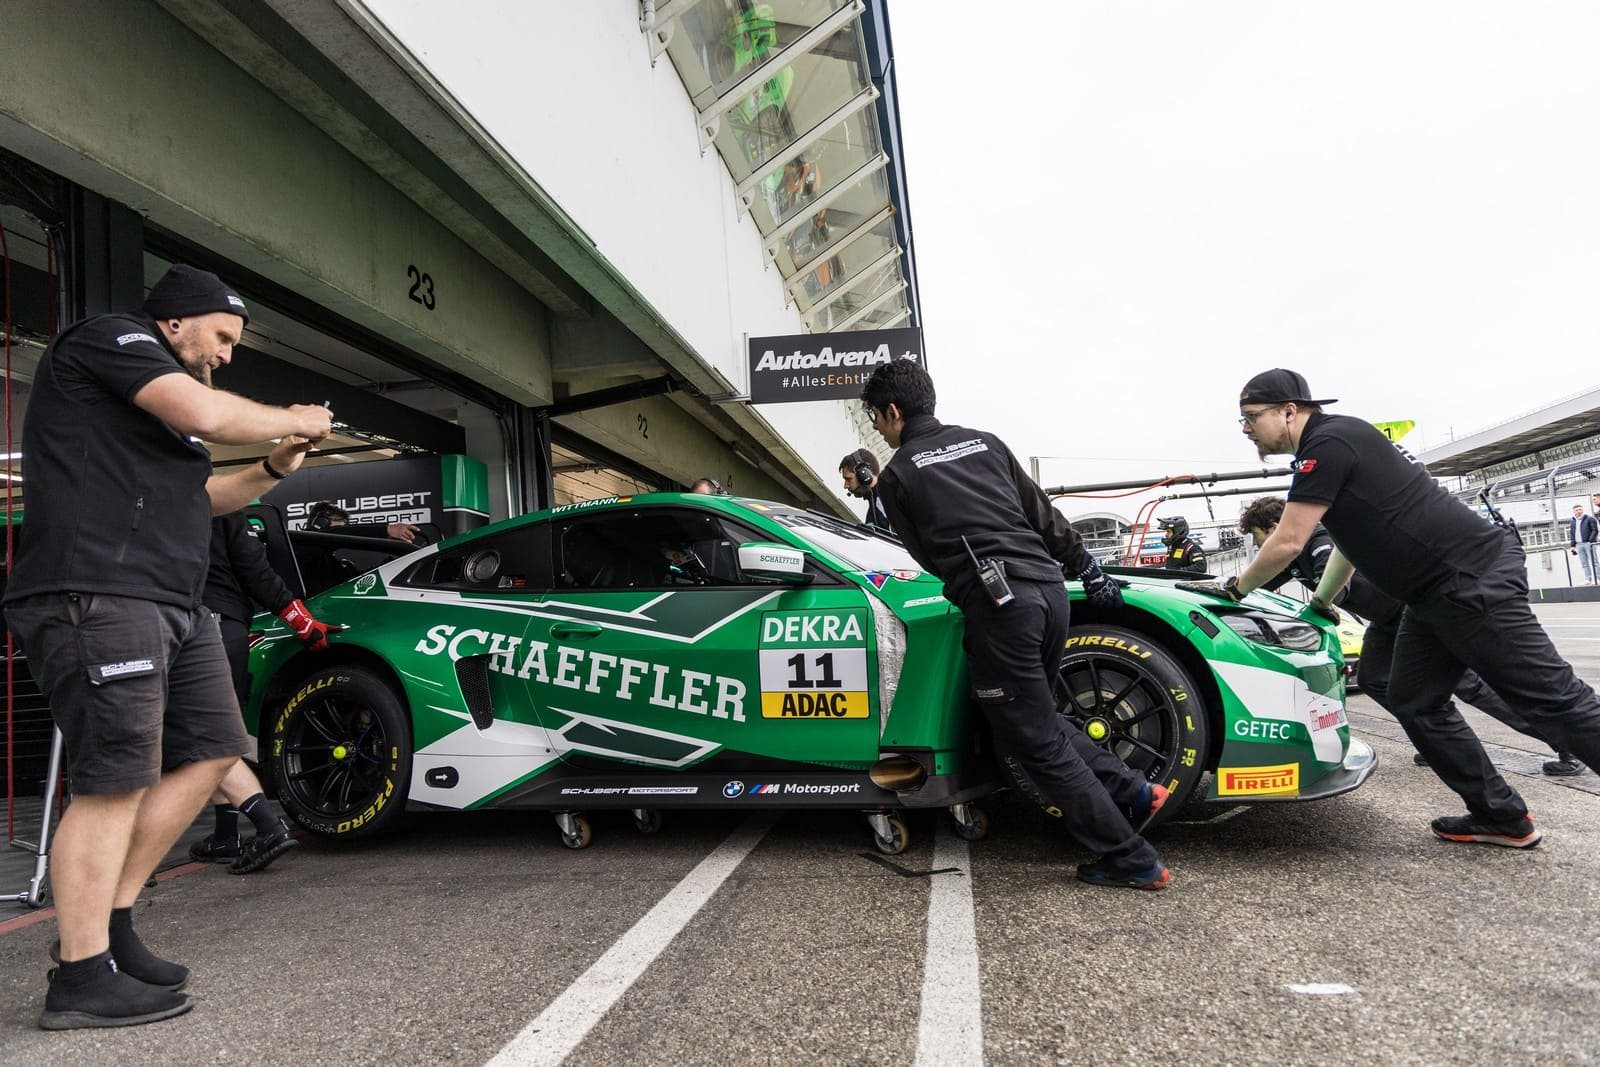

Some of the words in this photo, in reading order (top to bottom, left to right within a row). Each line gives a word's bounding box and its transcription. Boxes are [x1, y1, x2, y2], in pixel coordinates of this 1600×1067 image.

[407, 264, 436, 311] 23
[754, 343, 892, 372] AutoArenA
[782, 371, 874, 388] #AllesEchtH
[637, 413, 649, 440] 22
[911, 438, 983, 462] SCHUBERT
[551, 497, 619, 514] WITTMANN
[760, 554, 801, 566] SCHAEFFLER
[763, 613, 865, 643] DEKRA
[1065, 635, 1153, 660] PIRELLI
[414, 624, 748, 723] SCHAEFFLER
[787, 652, 842, 689] 11
[274, 676, 334, 733] PIRELLI
[781, 692, 848, 718] ADAC
[1234, 720, 1290, 740] GETEC
[629, 787, 697, 795] MOTORSPORT
[784, 783, 861, 795] Motorsport
[1226, 769, 1295, 791] PIRELLI
